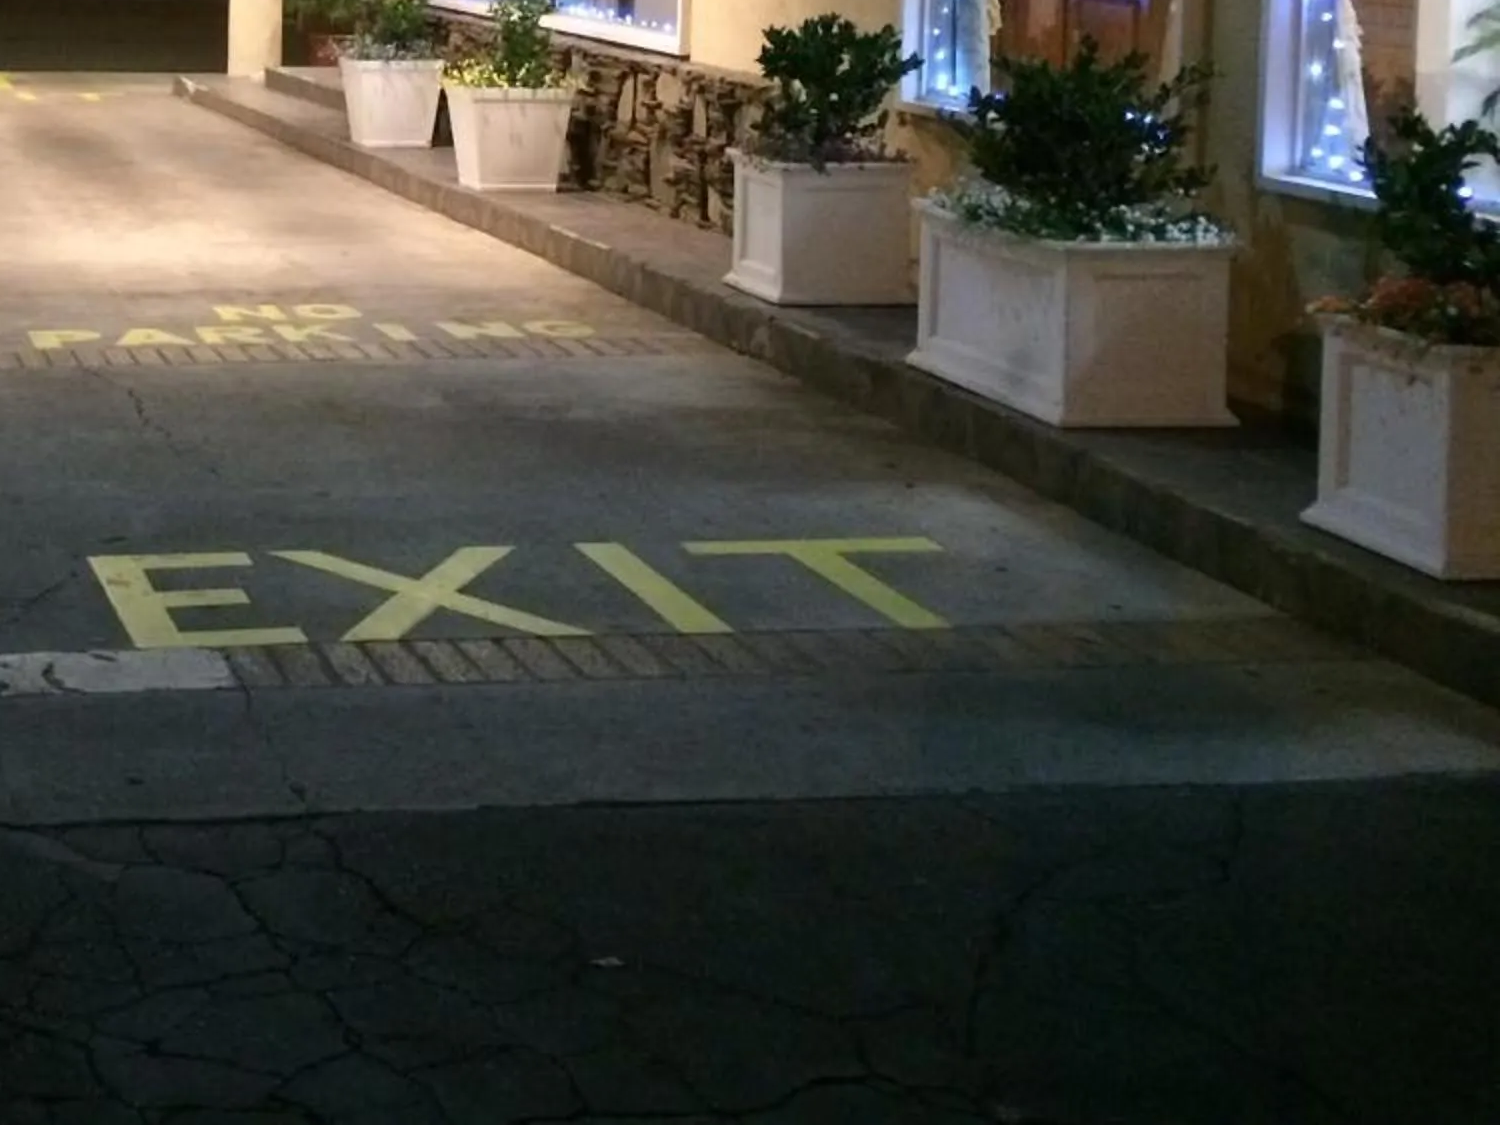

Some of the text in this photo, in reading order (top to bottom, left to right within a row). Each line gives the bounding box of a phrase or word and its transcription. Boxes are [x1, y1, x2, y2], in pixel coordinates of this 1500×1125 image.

[211, 303, 364, 321] NO
[26, 320, 597, 350] PARKING
[85, 536, 951, 650] EXIT
